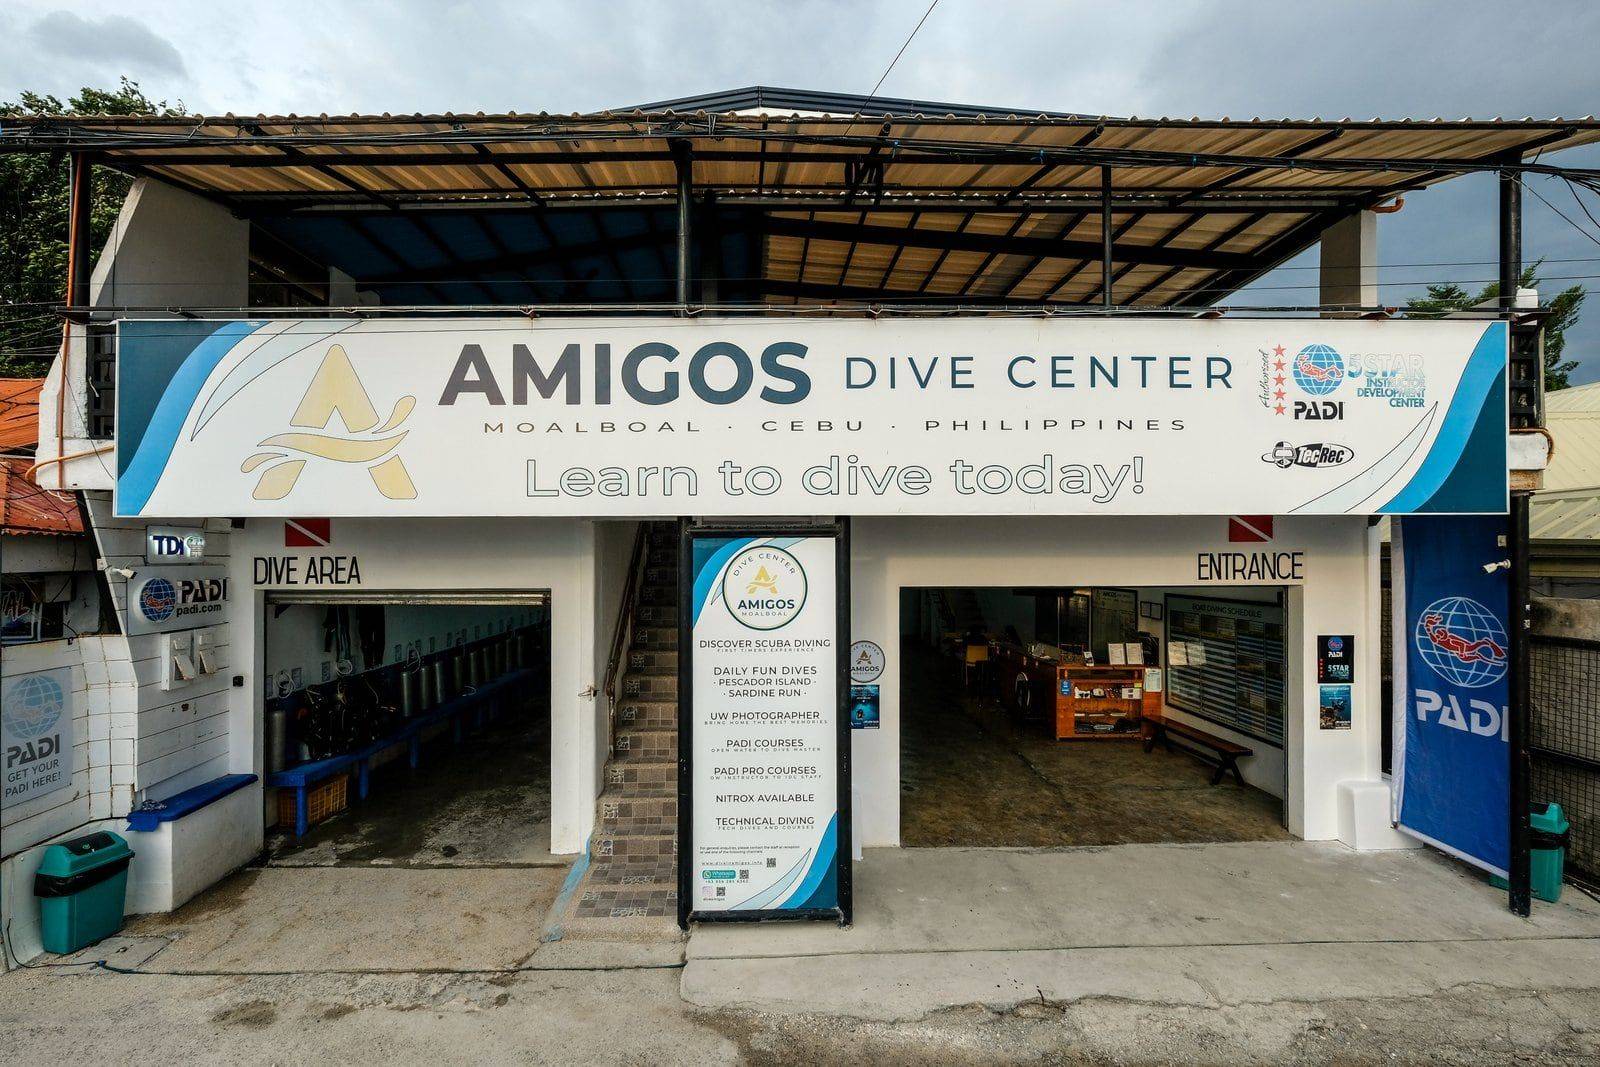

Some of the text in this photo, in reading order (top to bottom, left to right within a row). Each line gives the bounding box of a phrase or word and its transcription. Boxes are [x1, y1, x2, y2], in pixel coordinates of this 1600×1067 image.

[439, 341, 1233, 406] AMIGOS DIVE CENTER
[1294, 402, 1344, 420] PADI
[1390, 398, 1425, 408] CENTER
[484, 418, 1185, 434] MOALBOAL CEBU PHILIPPINES
[1299, 446, 1344, 464] TecRec
[526, 453, 1144, 504] Learn to dive today!
[254, 556, 361, 585] DIVE AREA
[733, 553, 796, 577] DIVE CENTER
[1198, 552, 1304, 581] ENTRANCE
[179, 578, 228, 604] PADI
[176, 603, 222, 617] padi.com
[738, 599, 795, 610] AMIGOS
[1228, 606, 1262, 618] SCHEDULE
[700, 639, 831, 648] DISCOVER SCUBA DIVING
[714, 666, 817, 676] DAILY FUN DIVES
[732, 712, 820, 720] PHOTOGRAPHER
[1415, 688, 1509, 742] PADI
[7, 734, 60, 768] PADI
[8, 758, 59, 782] GET YOUR
[714, 767, 739, 775] PADI
[6, 771, 61, 798] PADI HERE!
[758, 794, 814, 802] AVAILABLE
[716, 817, 775, 825] TECHNICAL
